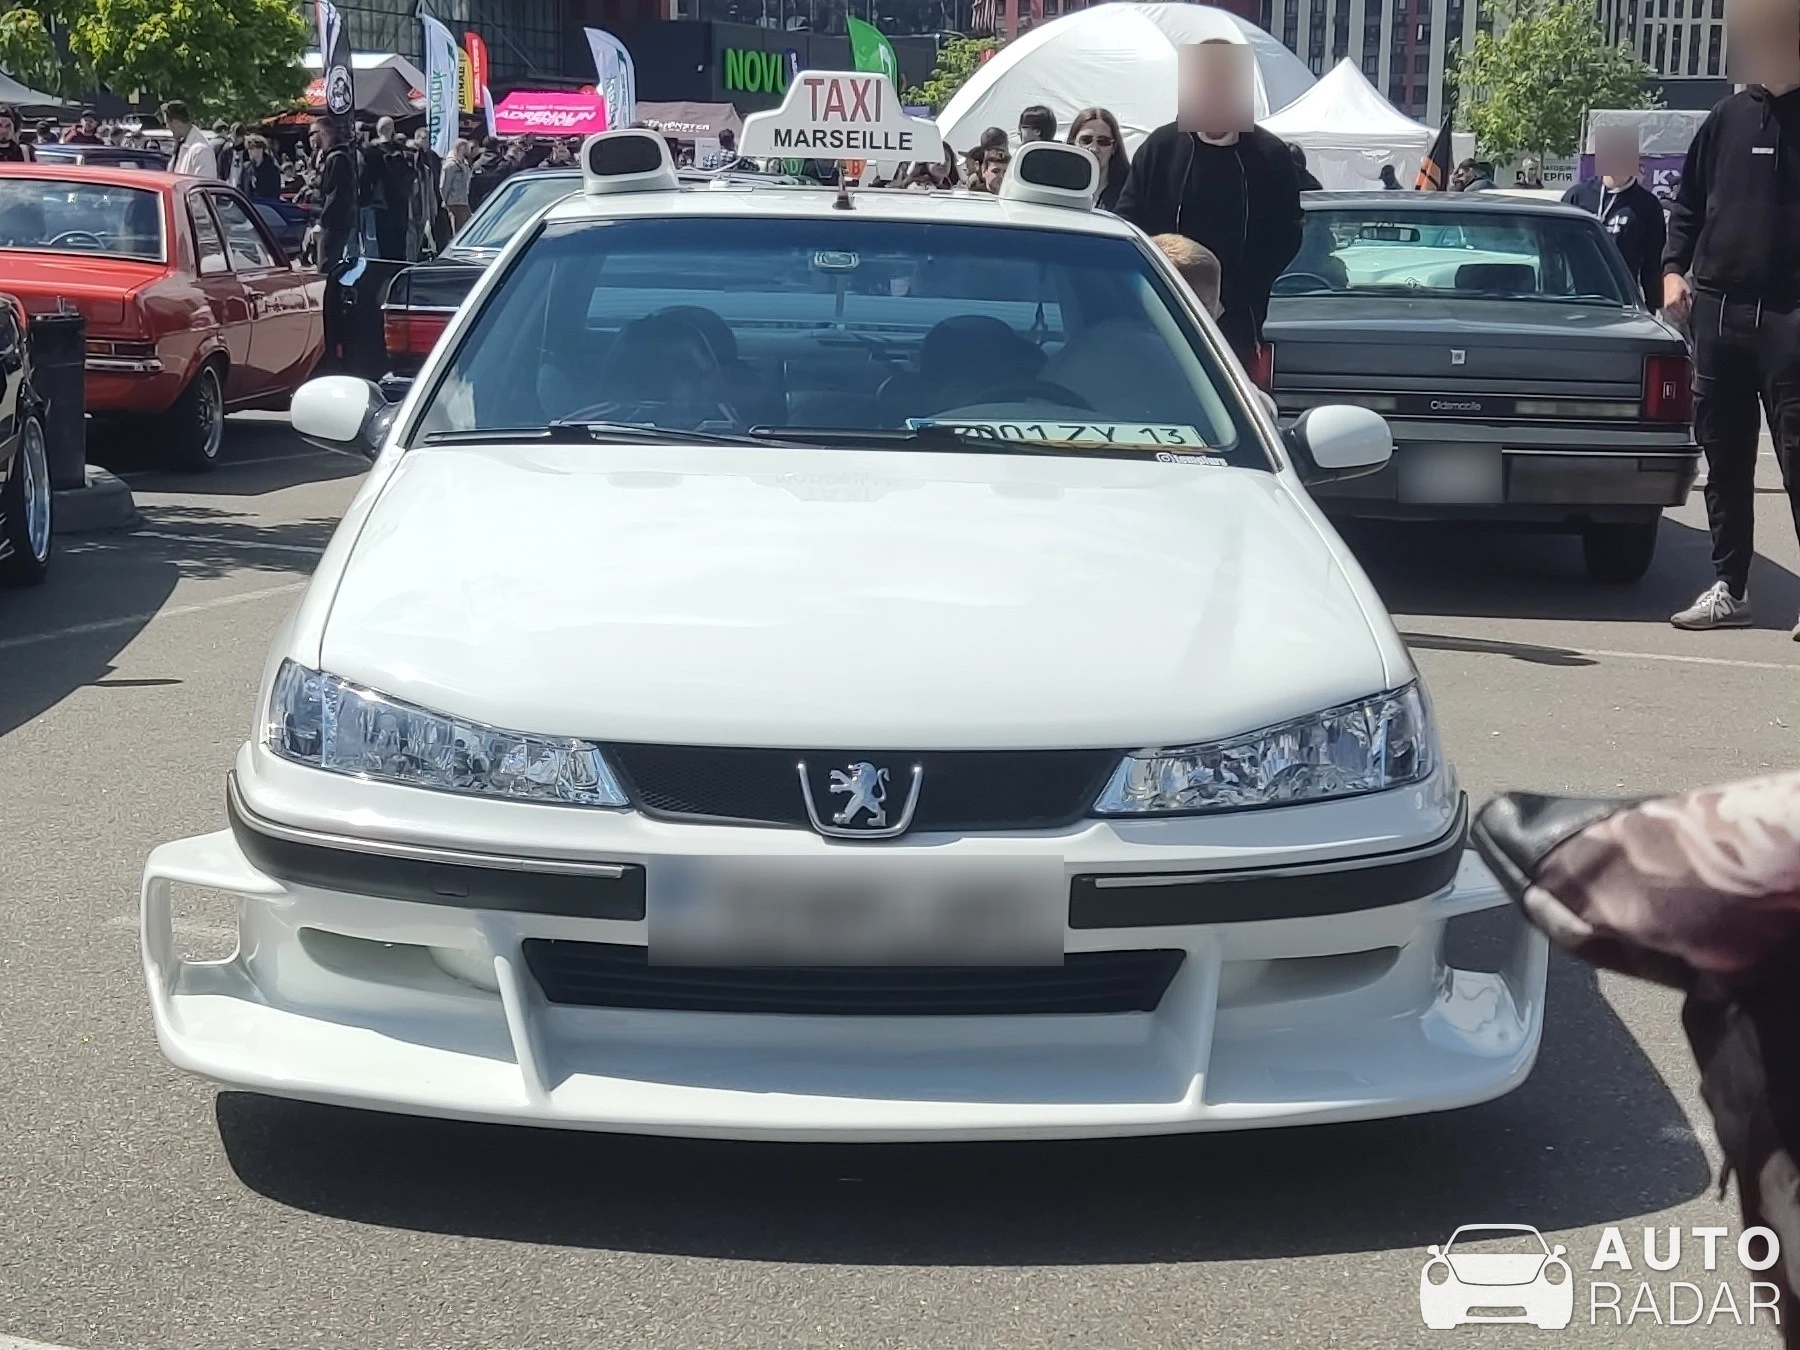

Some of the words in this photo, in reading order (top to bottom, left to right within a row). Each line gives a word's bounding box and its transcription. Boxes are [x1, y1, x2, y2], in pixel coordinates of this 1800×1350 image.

[725, 47, 789, 95] NOVU
[803, 78, 882, 123] TAXI
[774, 128, 913, 151] MARSEILLE
[1139, 427, 1187, 445] 13
